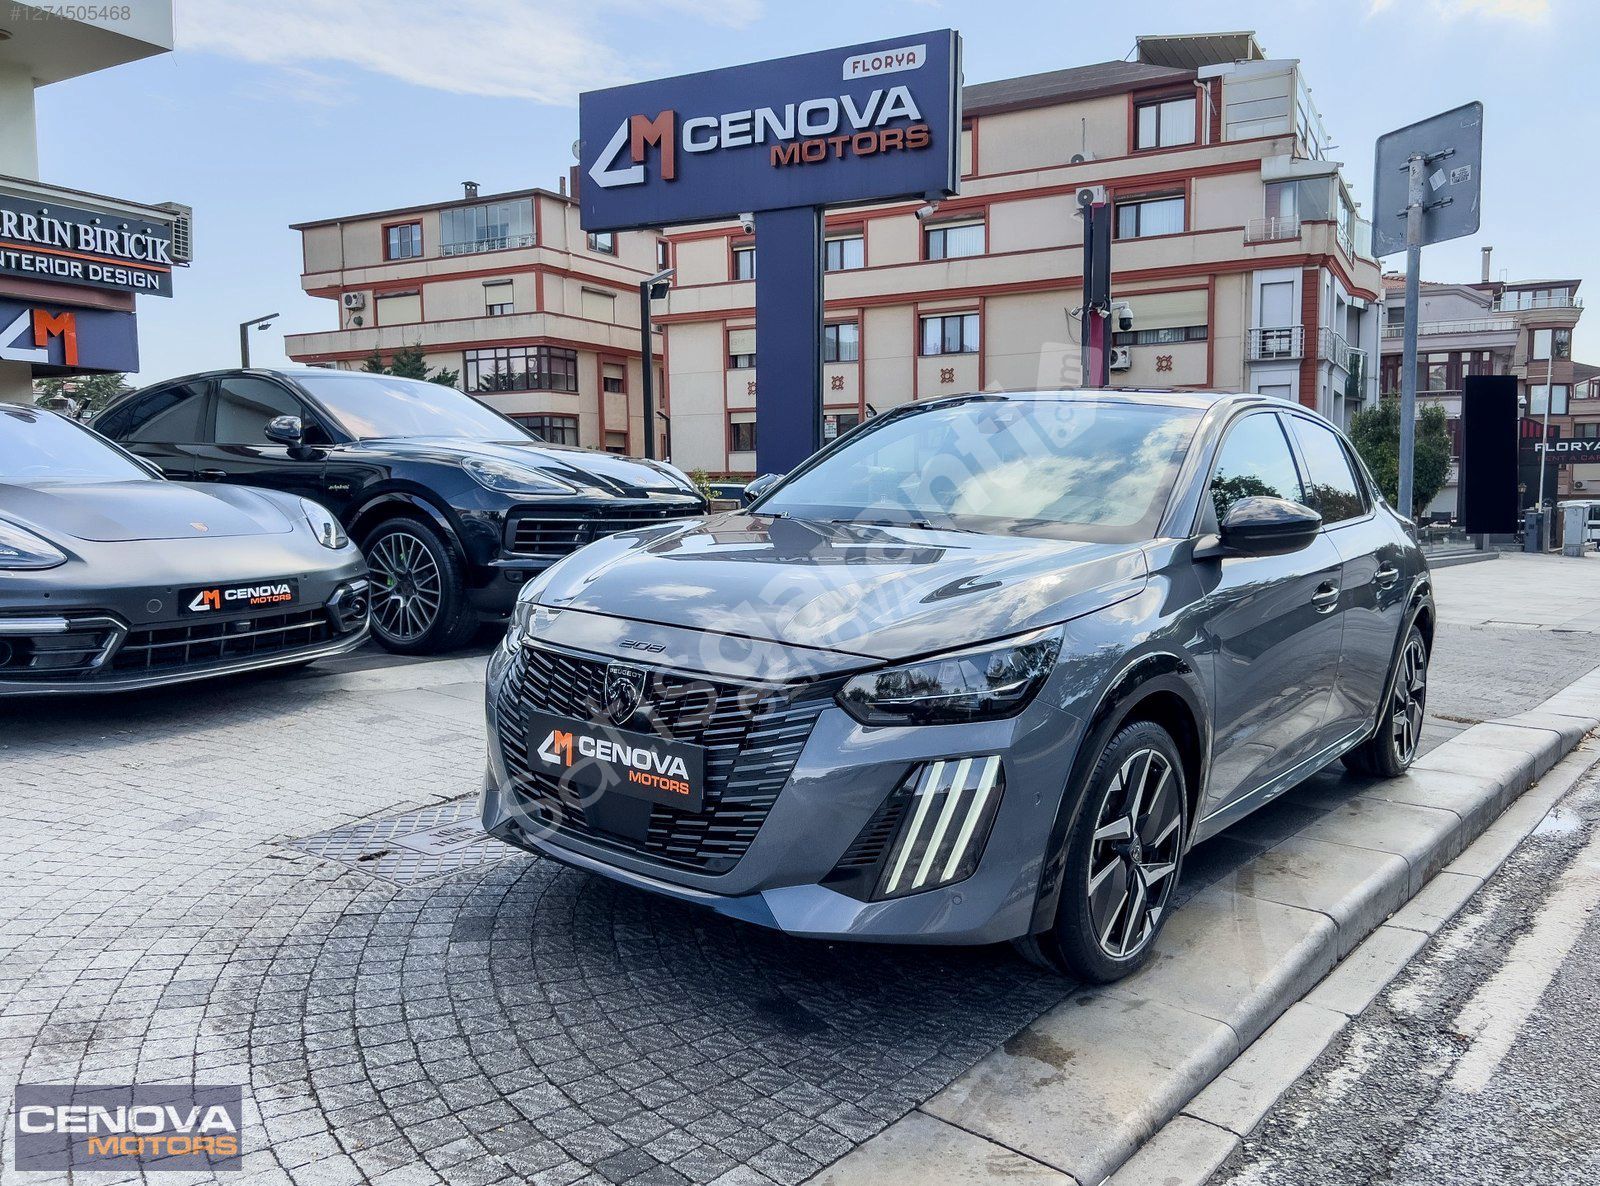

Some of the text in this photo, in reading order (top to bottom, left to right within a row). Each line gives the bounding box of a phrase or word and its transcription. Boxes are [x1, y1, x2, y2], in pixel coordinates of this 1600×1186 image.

[851, 51, 917, 74] FLORYA
[682, 85, 922, 153] CENOVA
[770, 124, 931, 168] MOTORS
[0, 208, 73, 248] RRİN
[89, 265, 160, 290] DESIGN
[1534, 441, 1600, 452] FLORYA
[224, 584, 291, 600] CENOVA
[250, 594, 292, 605] MOTORS
[619, 638, 667, 653] 208
[609, 667, 643, 679] PEUGEOT
[578, 736, 689, 780] CENOVA
[629, 770, 690, 795] MOTORS
